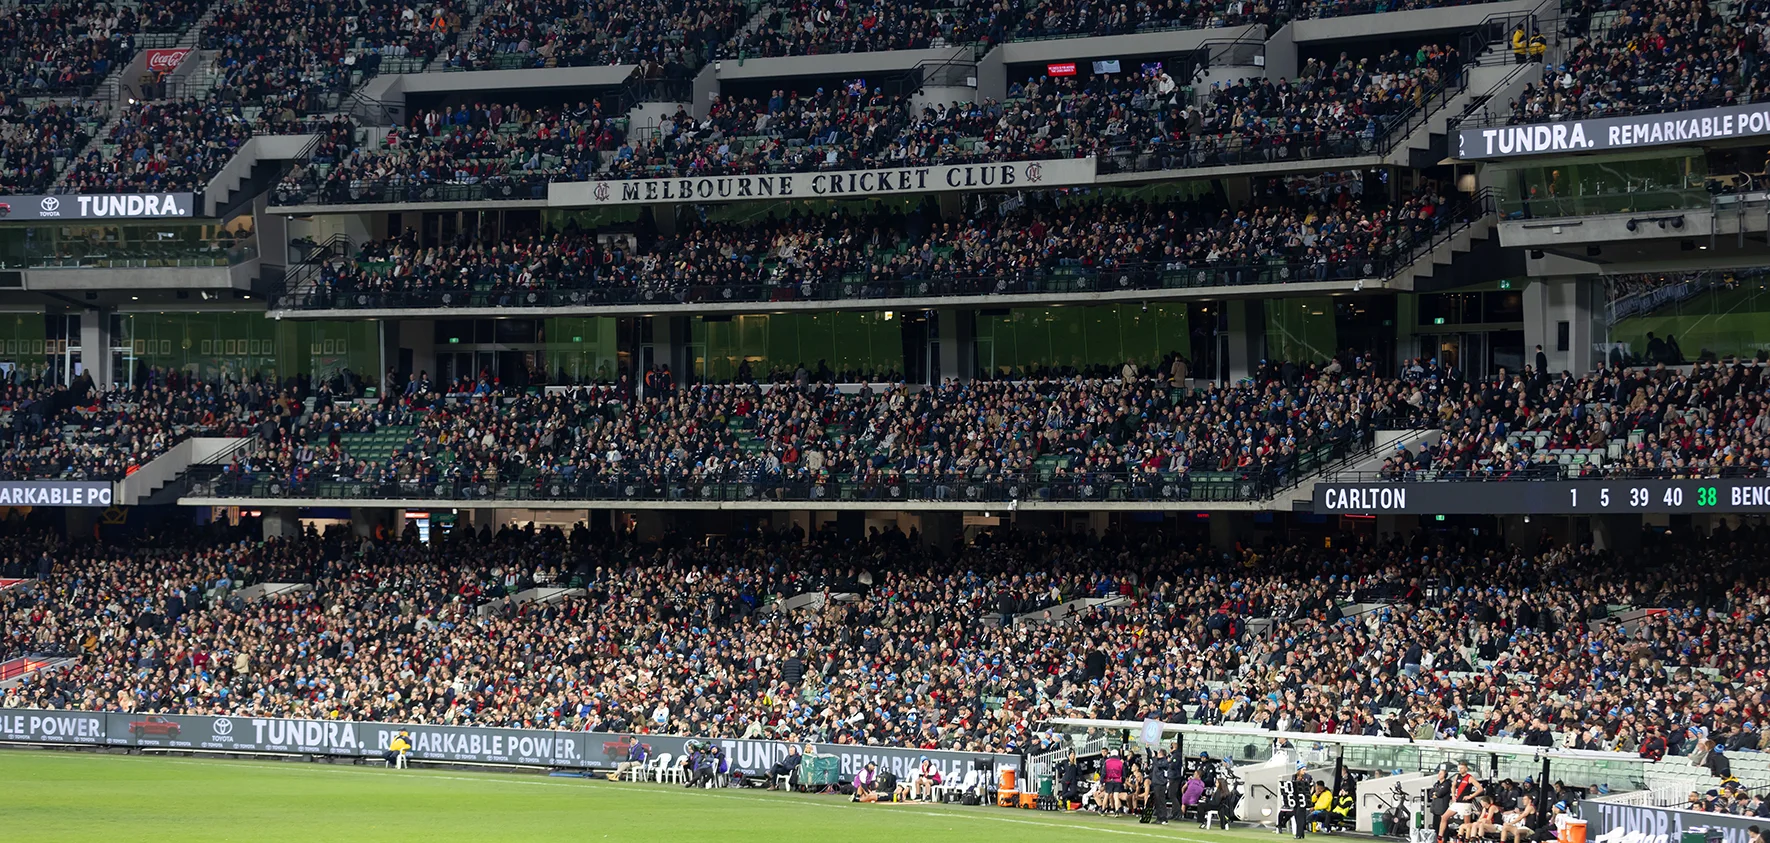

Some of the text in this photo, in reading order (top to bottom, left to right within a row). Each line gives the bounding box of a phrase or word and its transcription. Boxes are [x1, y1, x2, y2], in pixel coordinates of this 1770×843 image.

[1483, 123, 1594, 155] TUNDRA.
[1609, 115, 1733, 146] REMARKABLE
[622, 165, 1015, 201] MELBOURNE CRICKET CLUB
[77, 195, 185, 216] TUNDRA.
[0, 487, 111, 504] ARKABLE PO
[1325, 488, 1406, 509] CARLTON
[1570, 488, 1577, 507] 1
[1600, 488, 1610, 507] 5
[1629, 488, 1649, 507] 39
[1662, 487, 1683, 507] 40
[1697, 487, 1717, 506] 38
[0, 715, 106, 738] LE POWER.
[252, 719, 365, 749] TUNDRA.
[508, 736, 581, 760] POWER.
[722, 741, 817, 769] TUND
